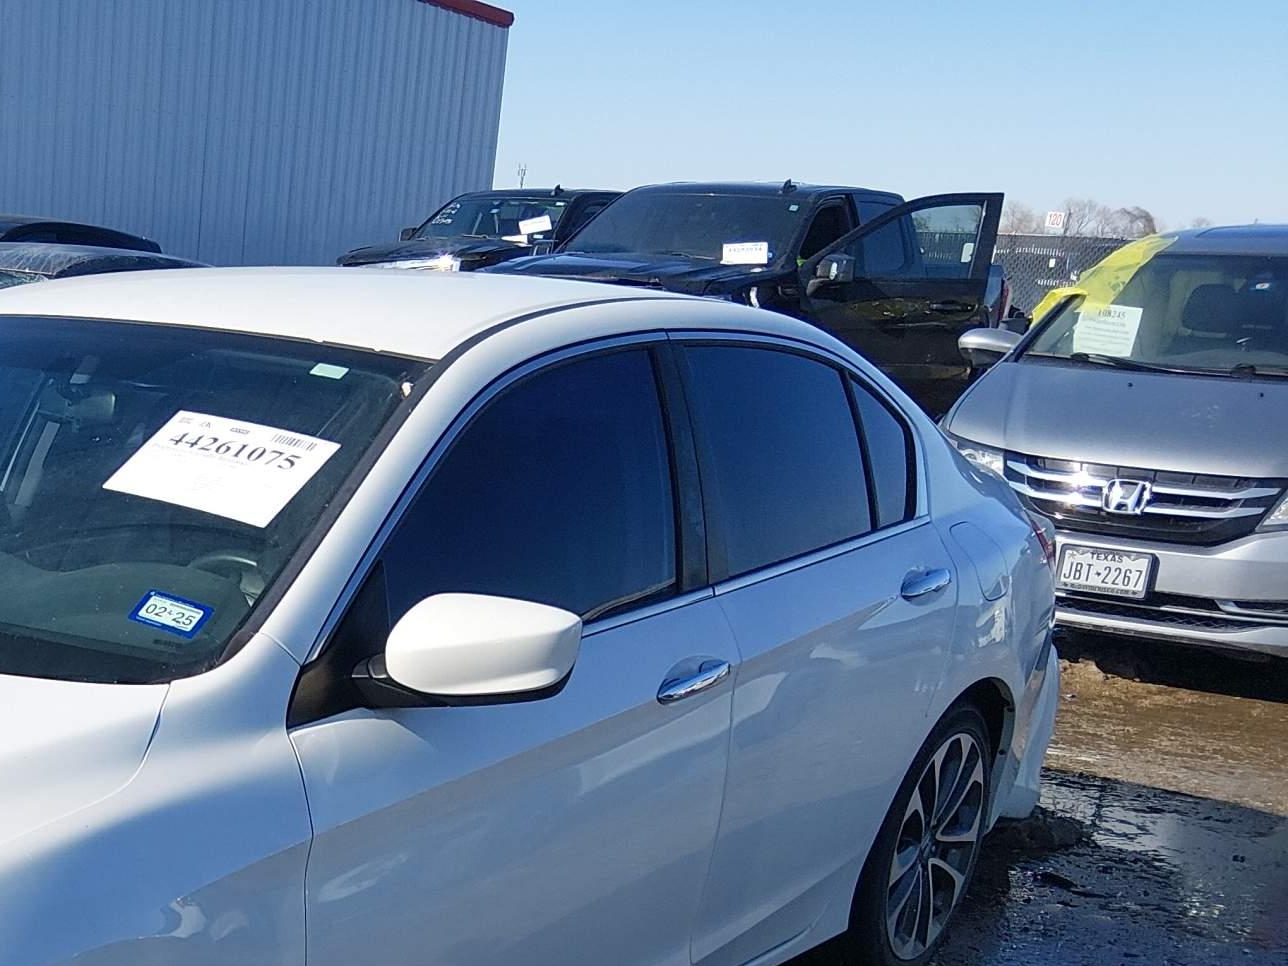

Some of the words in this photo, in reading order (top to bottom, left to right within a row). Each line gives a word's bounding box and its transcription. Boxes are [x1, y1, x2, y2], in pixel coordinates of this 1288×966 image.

[1048, 213, 1062, 226] 120
[167, 431, 302, 470] 44261075
[1089, 551, 1124, 564] TEXAS
